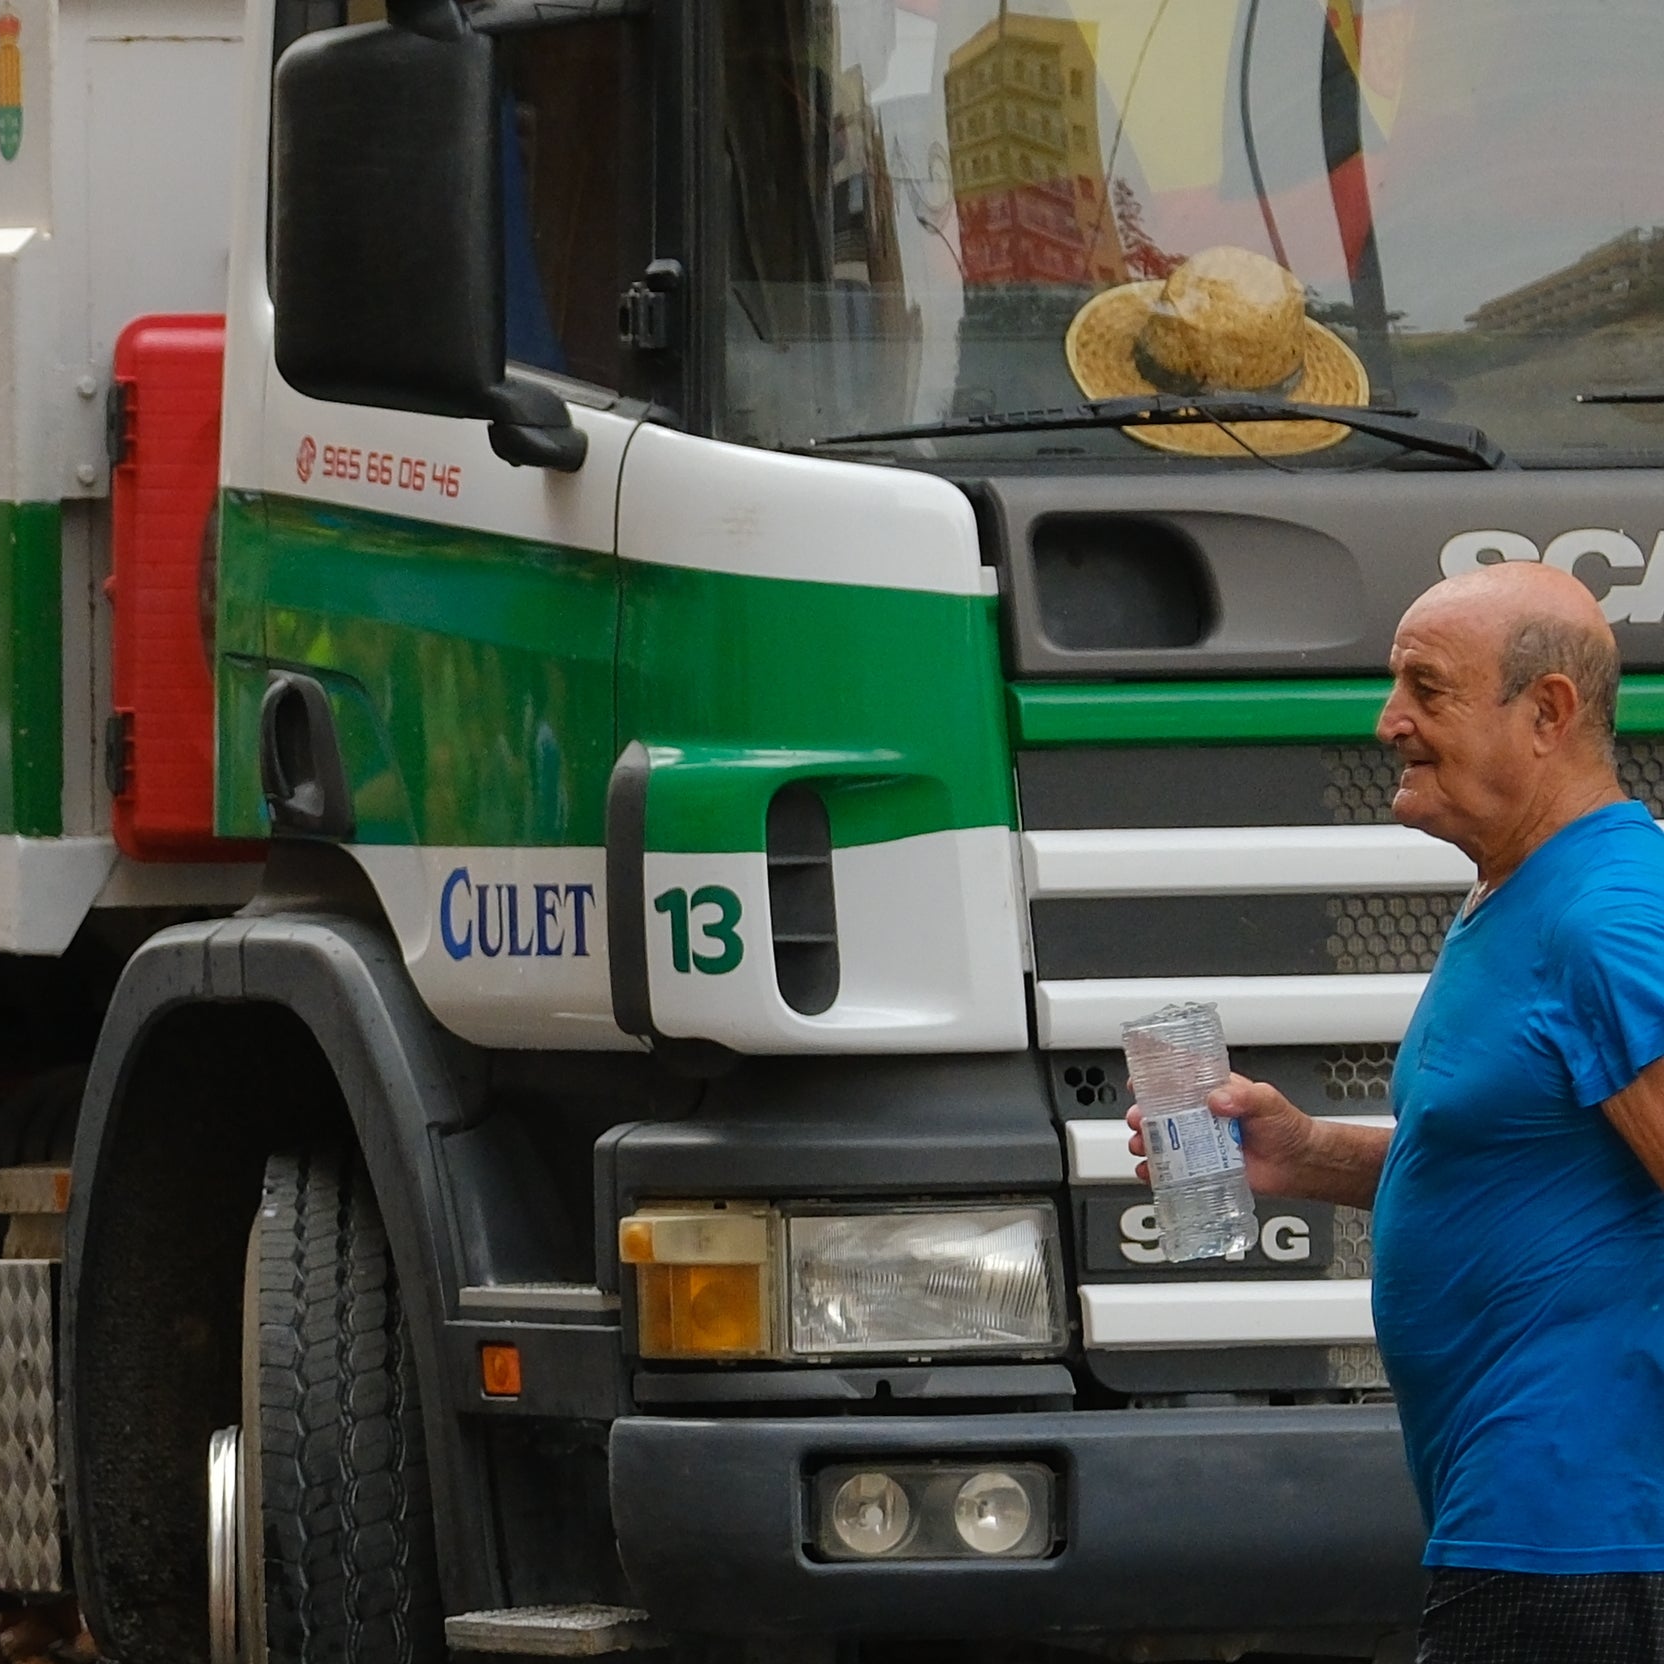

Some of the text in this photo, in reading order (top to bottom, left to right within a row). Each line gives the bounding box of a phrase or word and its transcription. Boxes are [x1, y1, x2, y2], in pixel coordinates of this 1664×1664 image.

[323, 445, 461, 497] 965 66 06 46
[440, 866, 596, 962] CULET
[654, 884, 744, 975] 13
